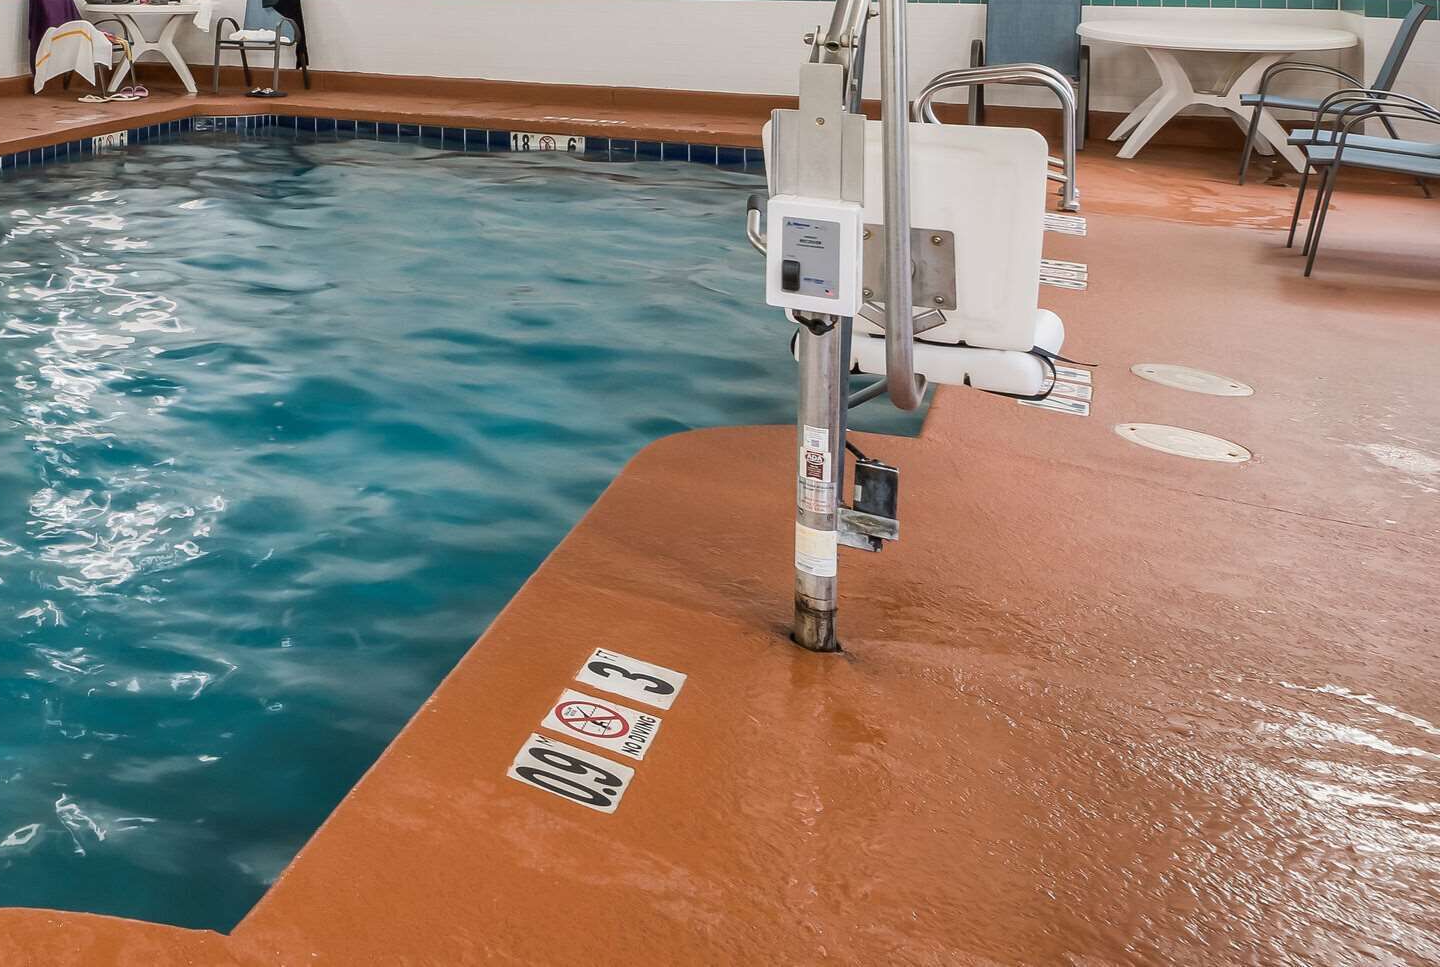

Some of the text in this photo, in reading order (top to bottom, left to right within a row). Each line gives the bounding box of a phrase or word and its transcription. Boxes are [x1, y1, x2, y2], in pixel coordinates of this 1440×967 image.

[587, 661, 675, 695] 3
[622, 715, 657, 757] NO DIVING
[515, 747, 624, 807] 0.9
